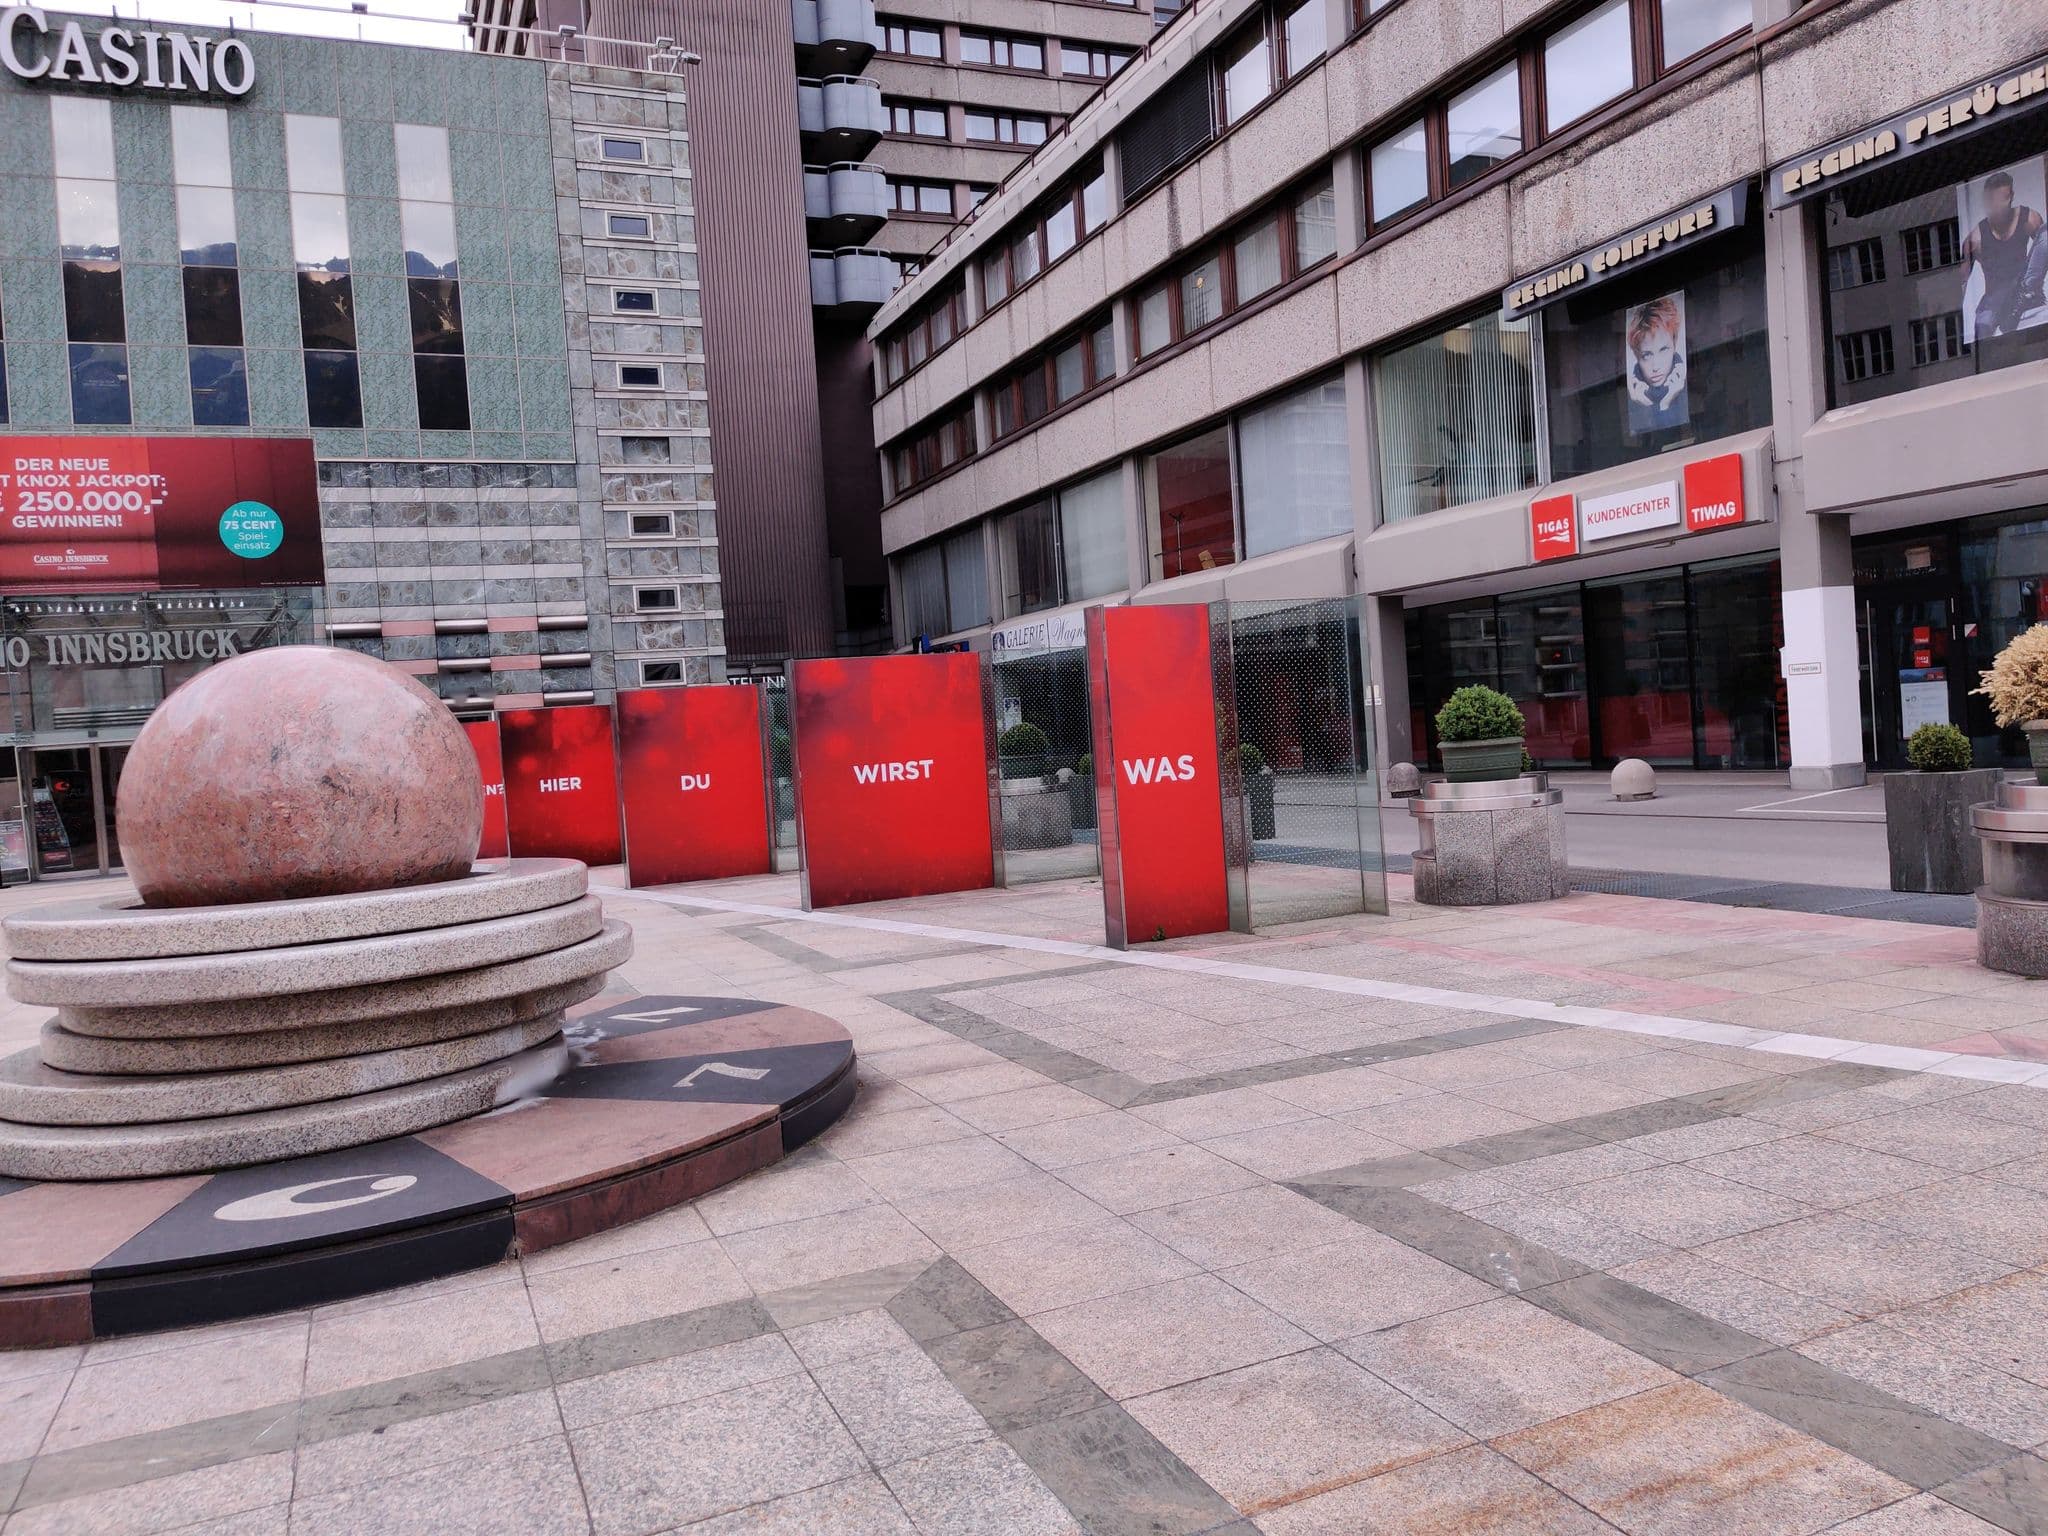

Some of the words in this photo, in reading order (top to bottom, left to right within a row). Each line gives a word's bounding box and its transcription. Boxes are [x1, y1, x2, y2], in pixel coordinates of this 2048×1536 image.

[0, 6, 256, 95] CASINO
[1782, 130, 1896, 194] REGINA
[1508, 263, 1585, 310] REGINA
[1591, 204, 1715, 273] COIFFURE
[15, 458, 54, 471] DER
[59, 458, 110, 471] NEUE
[16, 474, 71, 487] KNOX
[76, 474, 166, 487] JACKPOT:
[232, 509, 247, 518] Ab
[1586, 496, 1671, 525] KUNDENCENTER
[1691, 501, 1737, 523] TIWAG
[12, 514, 123, 528] GEWINNEN!
[224, 520, 239, 530] 75
[242, 520, 277, 530] CENT
[1537, 517, 1570, 535] TIGAS
[238, 532, 268, 541] Spiel-
[234, 541, 271, 550] einsatz
[33, 554, 63, 564] CASINO
[1006, 623, 1046, 649] GALERIE
[0, 636, 31, 667] O
[45, 628, 240, 666] INNSBRUCK
[852, 759, 934, 785] WIRST
[1122, 754, 1196, 785] WAS
[539, 776, 582, 793] HIER
[680, 774, 711, 791] DU
